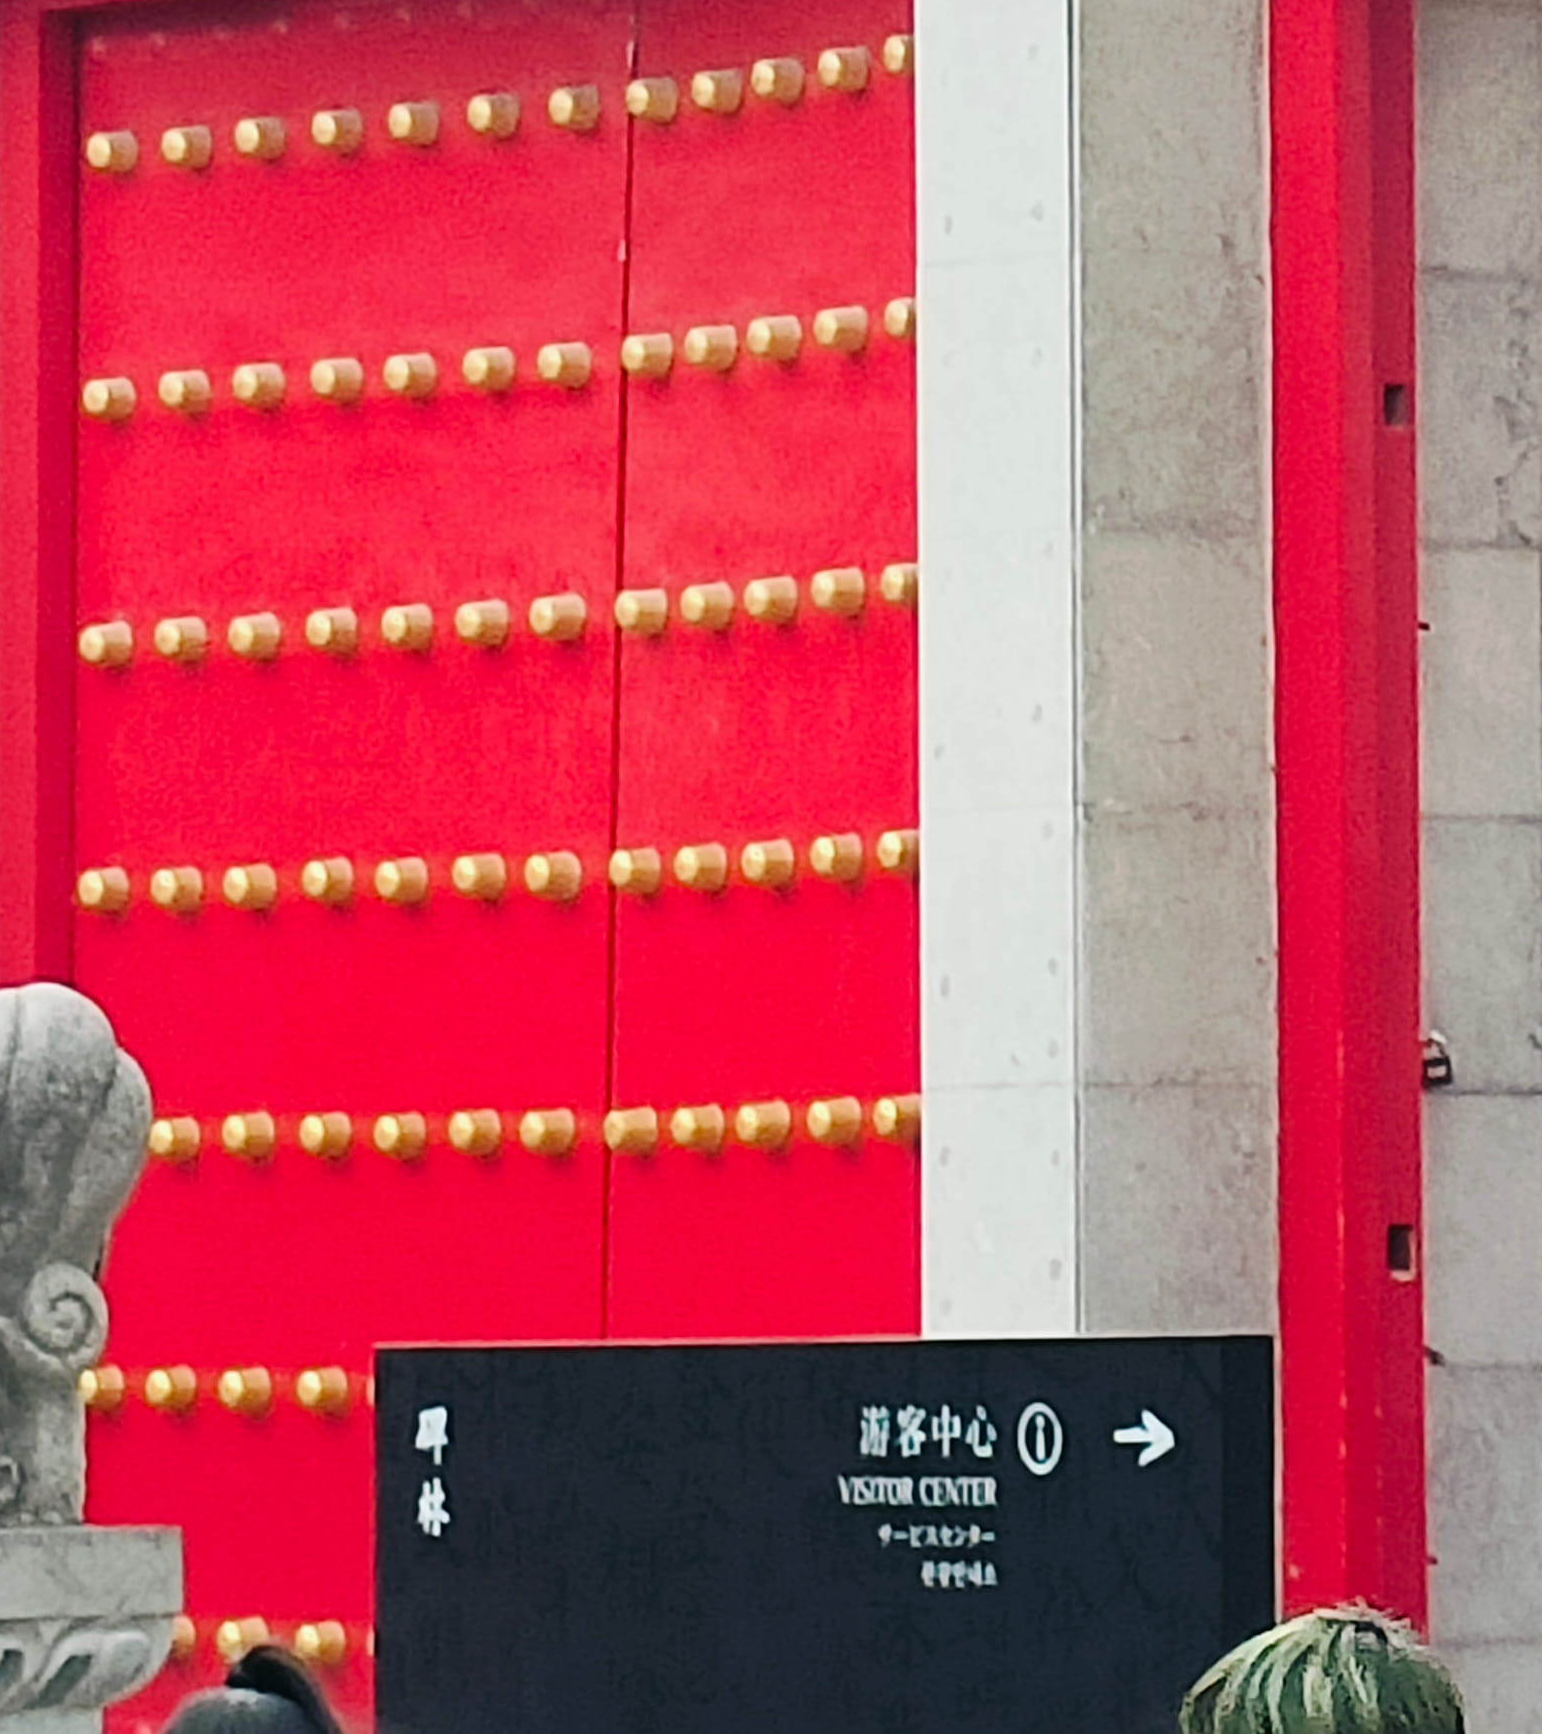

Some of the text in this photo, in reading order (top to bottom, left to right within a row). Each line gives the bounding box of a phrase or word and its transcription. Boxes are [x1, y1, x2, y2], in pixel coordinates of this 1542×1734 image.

[860, 1404, 998, 1458] 游客中心
[838, 1474, 997, 1506] VISITOR CENTER
